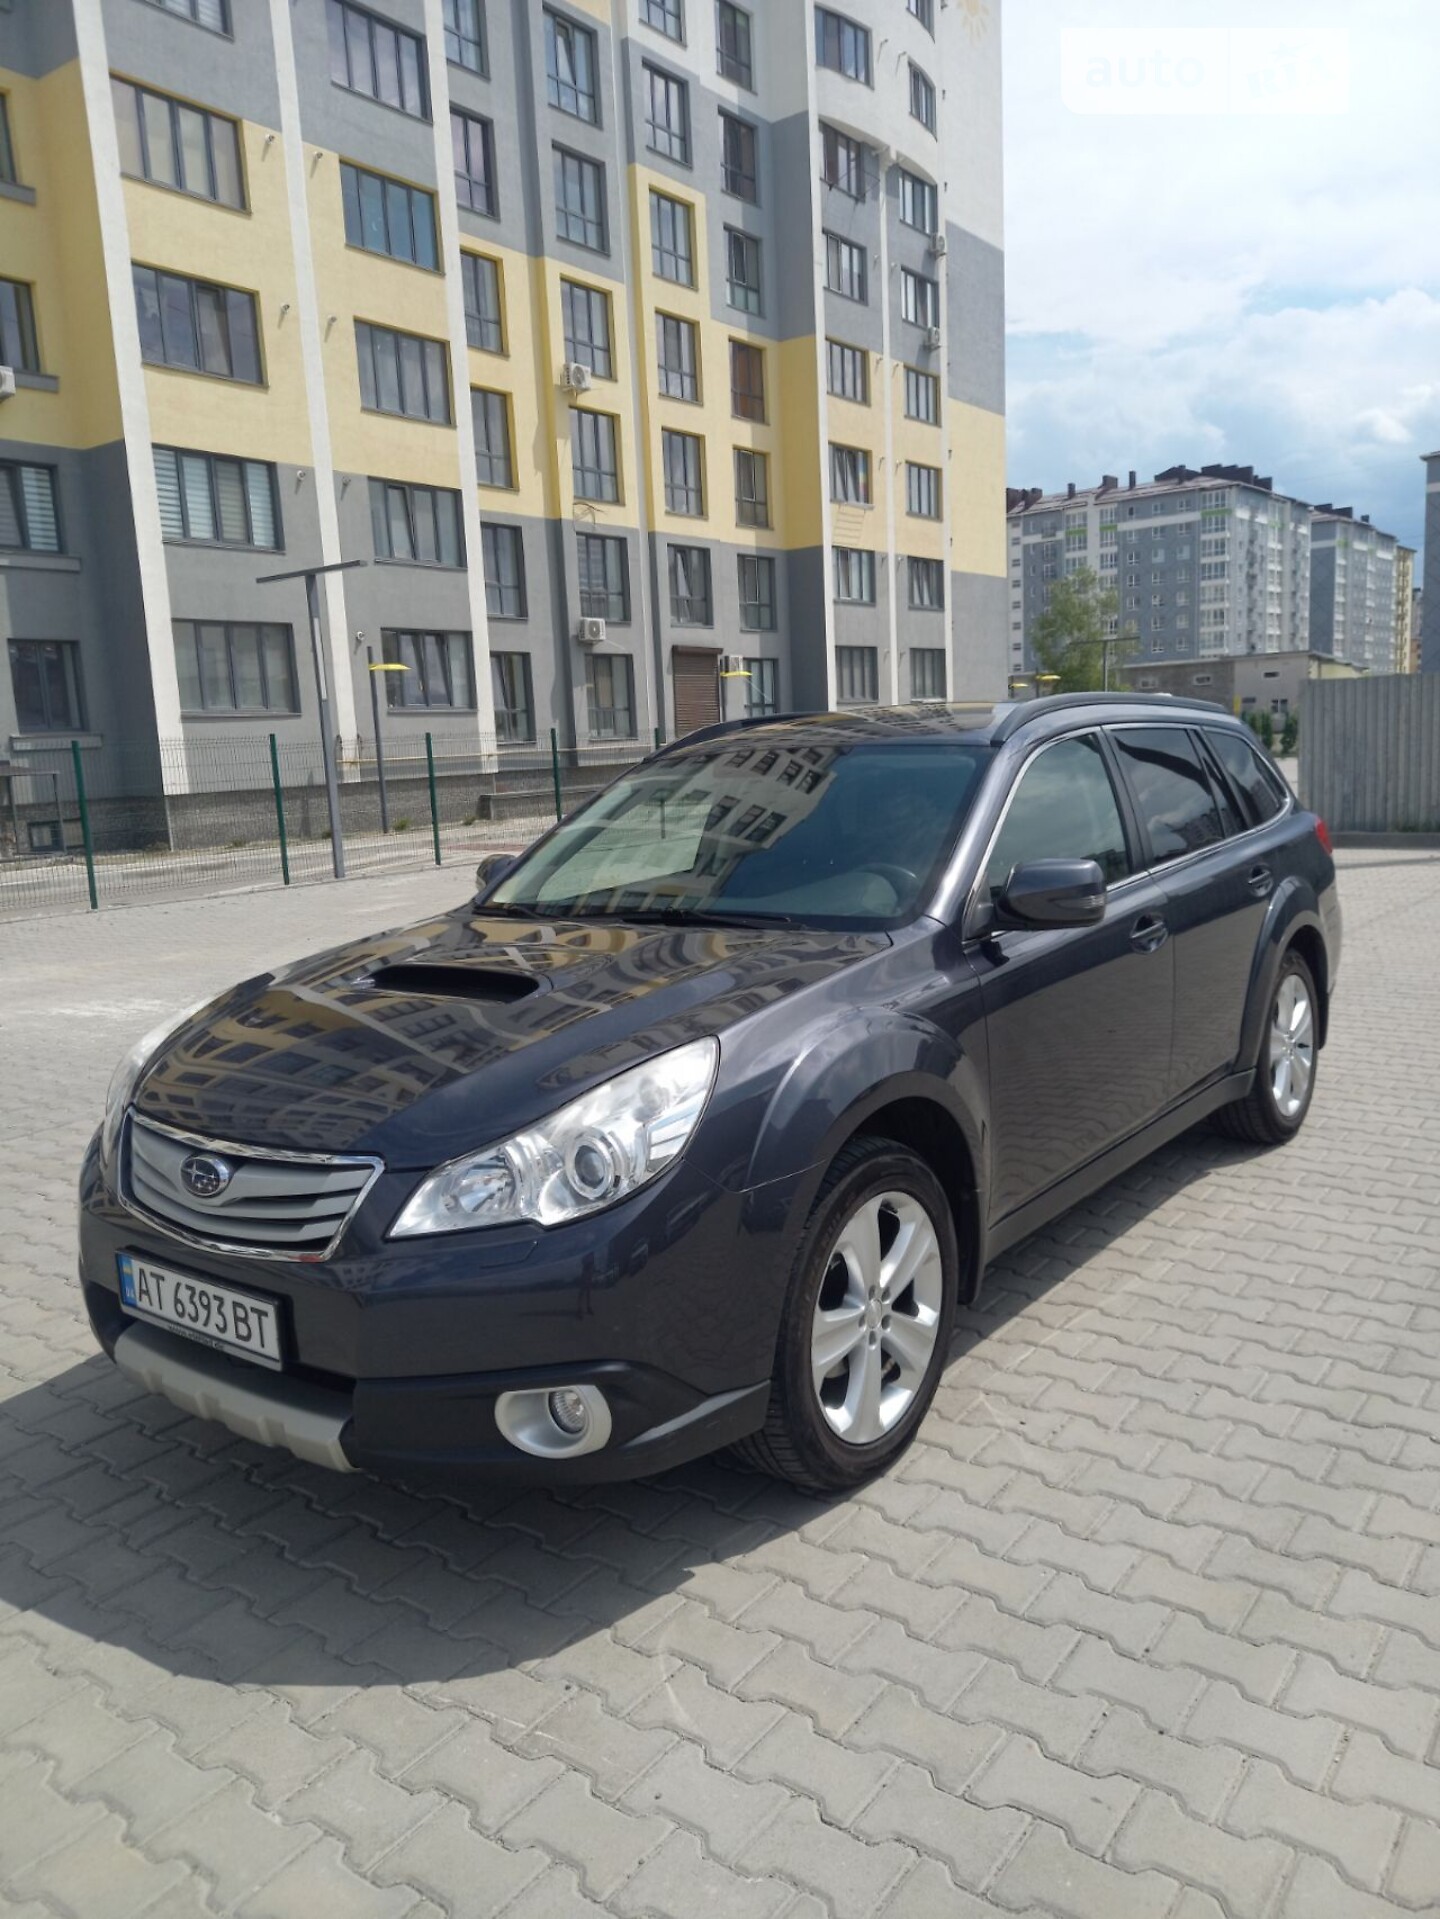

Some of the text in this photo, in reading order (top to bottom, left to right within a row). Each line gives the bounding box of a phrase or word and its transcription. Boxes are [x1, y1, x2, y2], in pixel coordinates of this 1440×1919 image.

[138, 1267, 165, 1311] AT
[173, 1281, 228, 1334] 6393
[231, 1300, 269, 1349] BT
